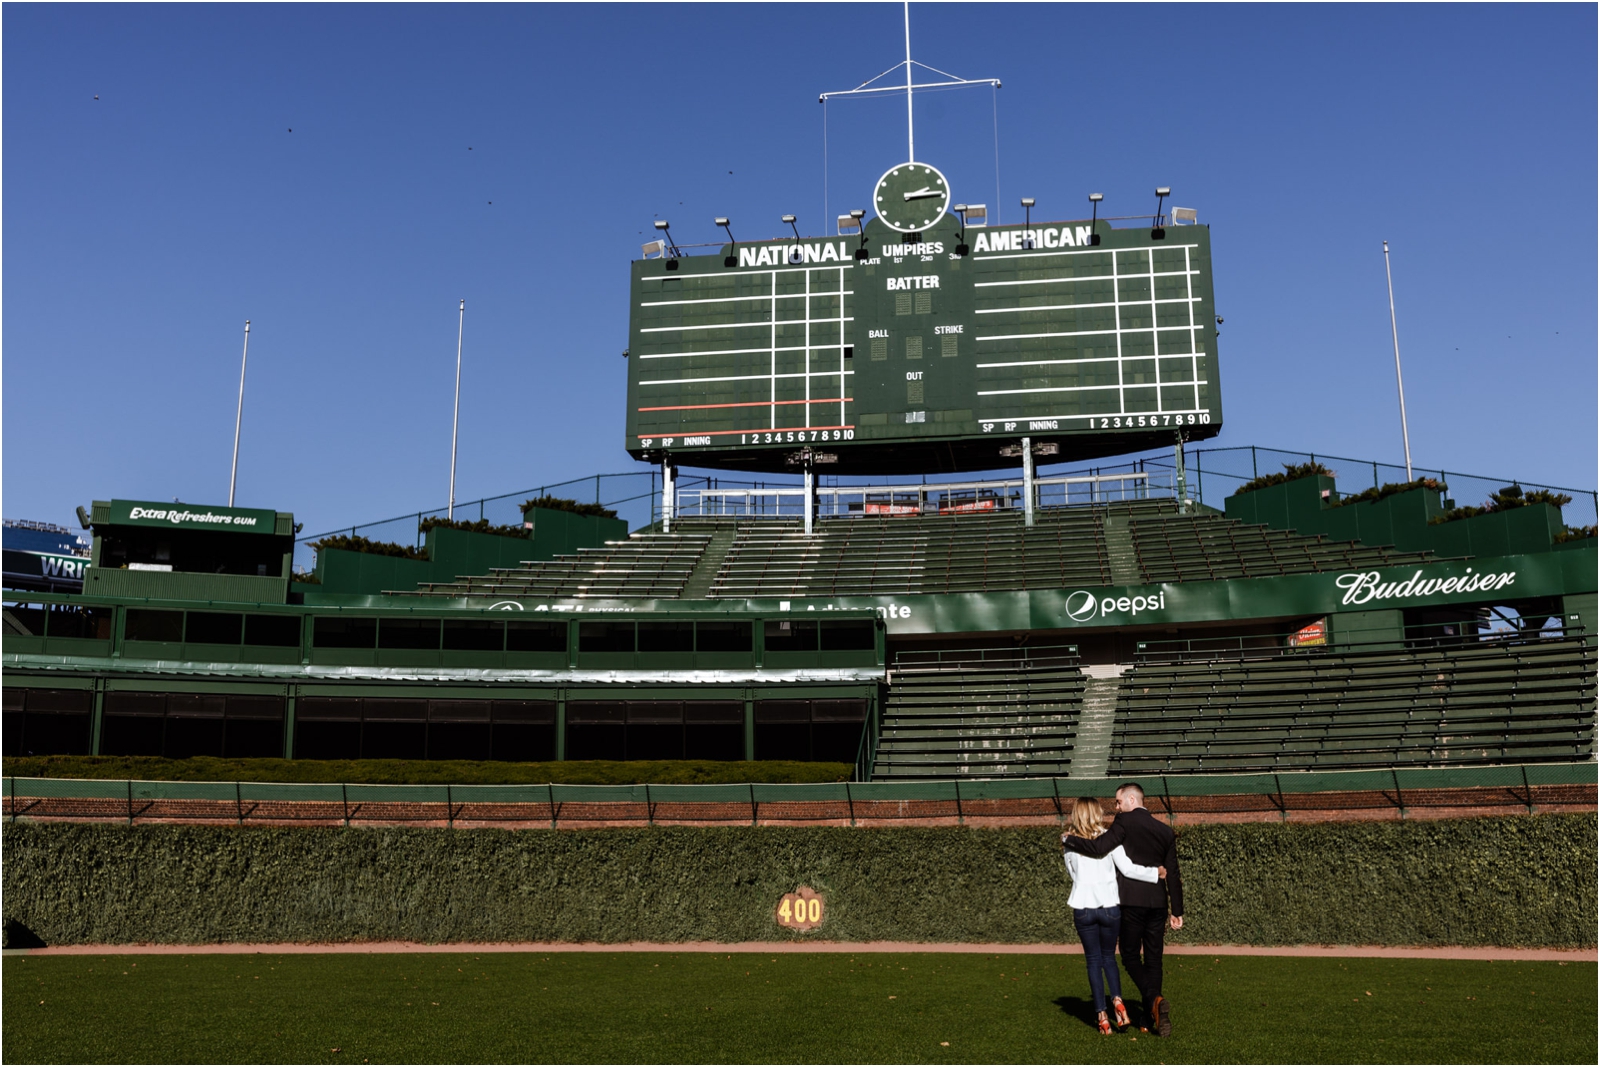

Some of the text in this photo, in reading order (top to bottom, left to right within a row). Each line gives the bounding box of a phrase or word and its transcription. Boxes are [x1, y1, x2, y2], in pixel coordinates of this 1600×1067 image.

[974, 226, 1091, 252] AMERICAN
[740, 242, 852, 267] NATIONAL
[882, 242, 944, 256] UMPIRES
[887, 275, 939, 290] BATTER
[869, 330, 889, 338] BALL
[935, 325, 963, 334] STRIKE
[906, 372, 923, 380] OUT
[982, 420, 1058, 432] SP RP INNING
[1101, 418, 1108, 428] 2
[1114, 417, 1121, 428] 3
[1126, 417, 1133, 427] 4
[1138, 416, 1145, 426] 5
[1150, 416, 1158, 426] 6
[1163, 415, 1170, 426] 7
[1176, 415, 1183, 425] 8
[1187, 414, 1195, 425] 9
[1199, 414, 1210, 424] 10
[641, 436, 711, 447] SP RP INNING
[752, 434, 759, 444] 2
[765, 433, 772, 443] 3
[775, 433, 782, 443] 4
[787, 432, 794, 442] 5
[798, 432, 805, 441] 6
[811, 431, 817, 441] 7
[822, 431, 829, 441] 8
[833, 430, 840, 440] 9
[844, 430, 854, 440] 10
[130, 507, 256, 525] Extra Refreshers GUM
[1336, 567, 1516, 605] Budweiser
[1101, 591, 1164, 617] pepsi
[779, 899, 820, 922] 400
